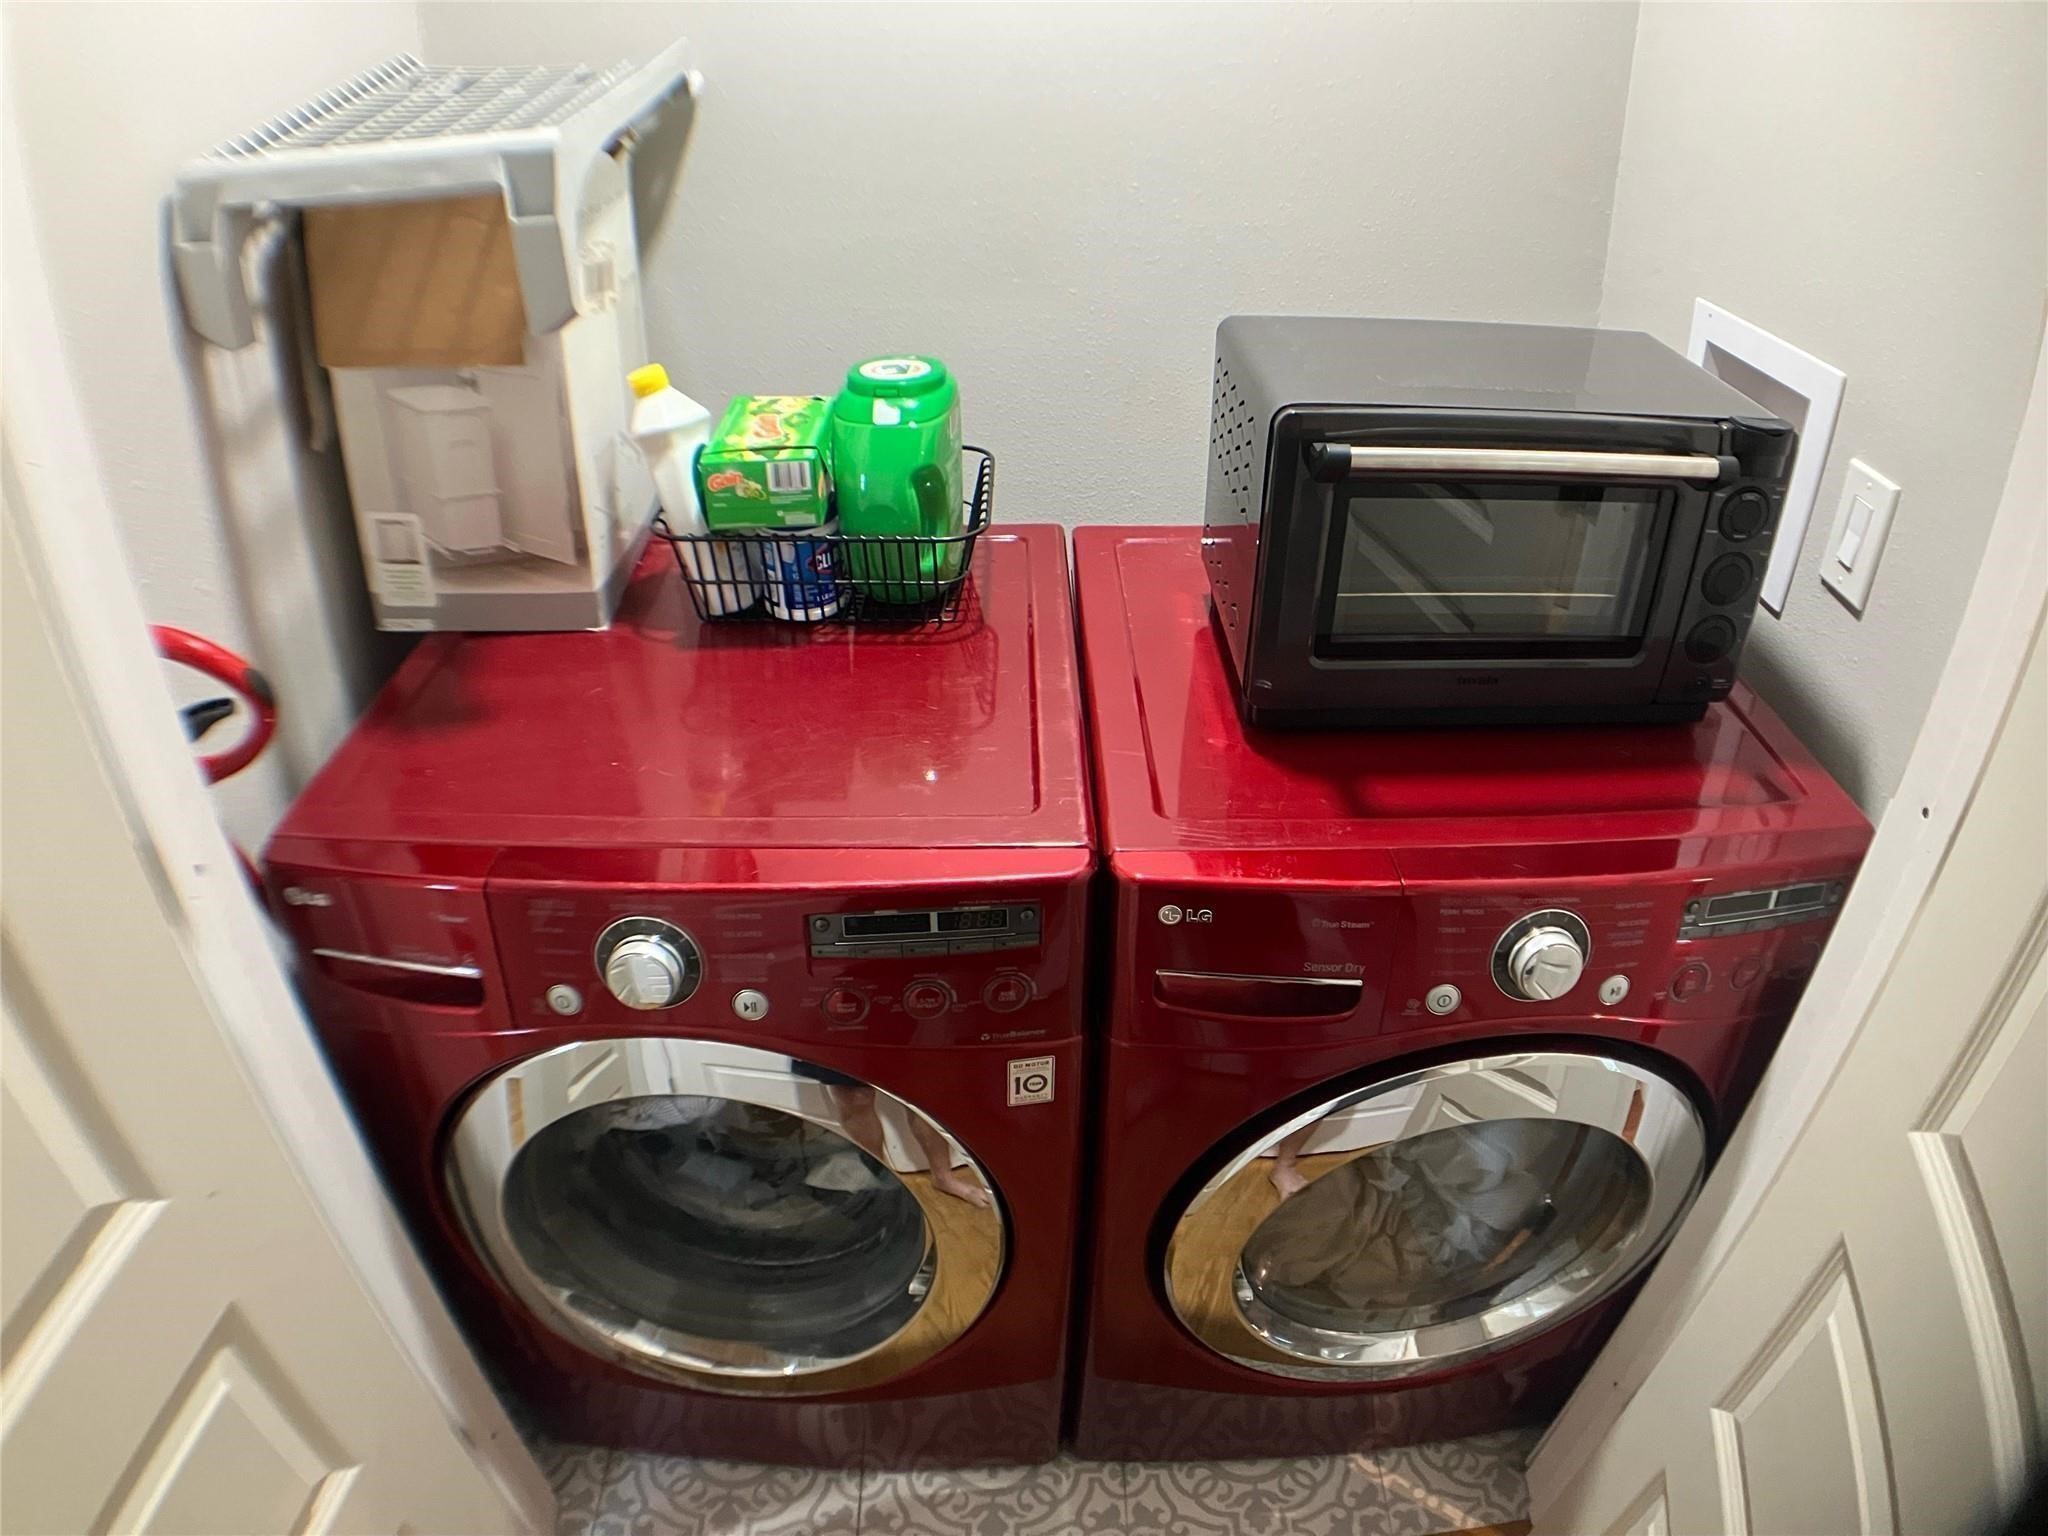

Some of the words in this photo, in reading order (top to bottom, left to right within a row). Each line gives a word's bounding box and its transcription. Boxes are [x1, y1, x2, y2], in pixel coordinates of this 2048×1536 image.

[1186, 908, 1213, 923] LG
[1303, 961, 1343, 973] Sensor
[1344, 962, 1366, 976] Dry
[1014, 1073, 1049, 1095] 10
